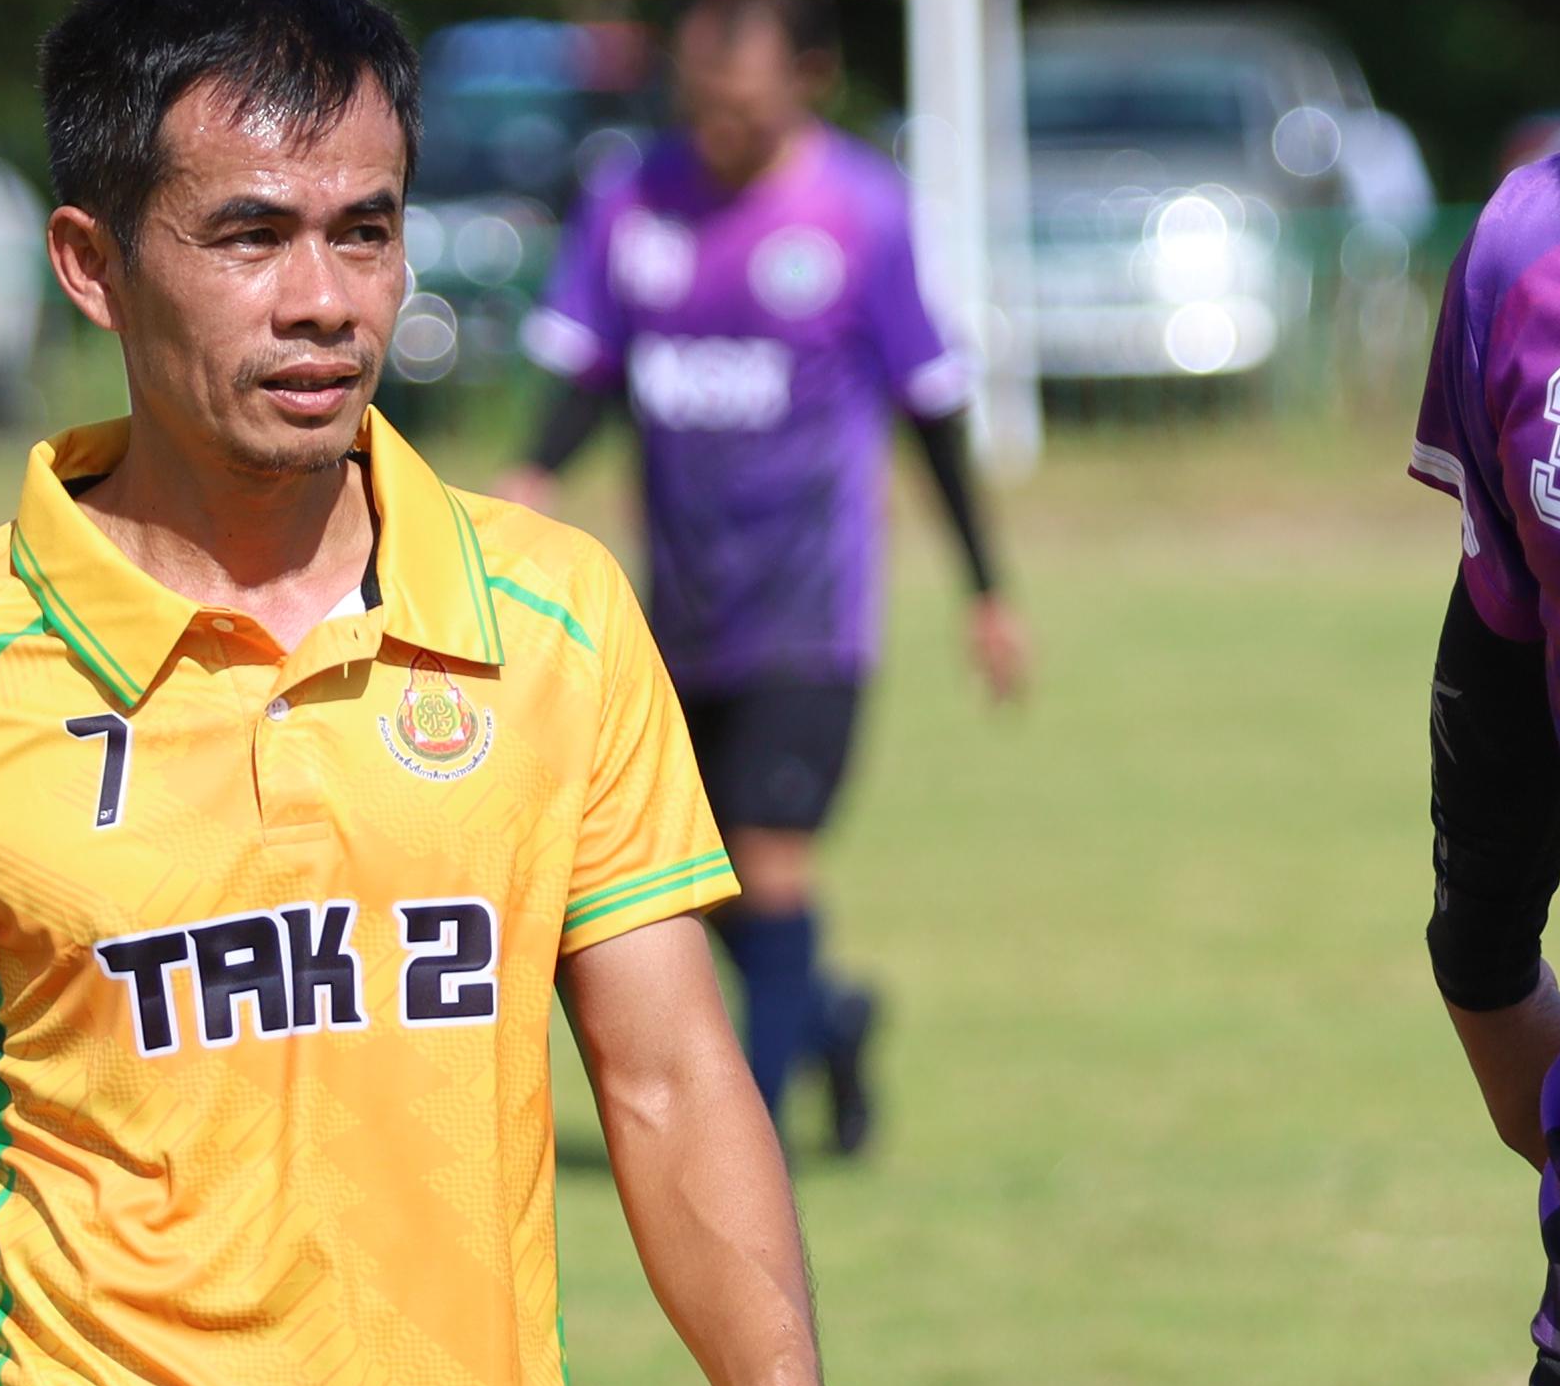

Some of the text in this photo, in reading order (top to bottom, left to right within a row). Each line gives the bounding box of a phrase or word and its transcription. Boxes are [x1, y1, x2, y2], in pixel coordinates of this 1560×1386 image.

[63, 712, 130, 828] 7
[94, 902, 496, 1053] TAK 2
